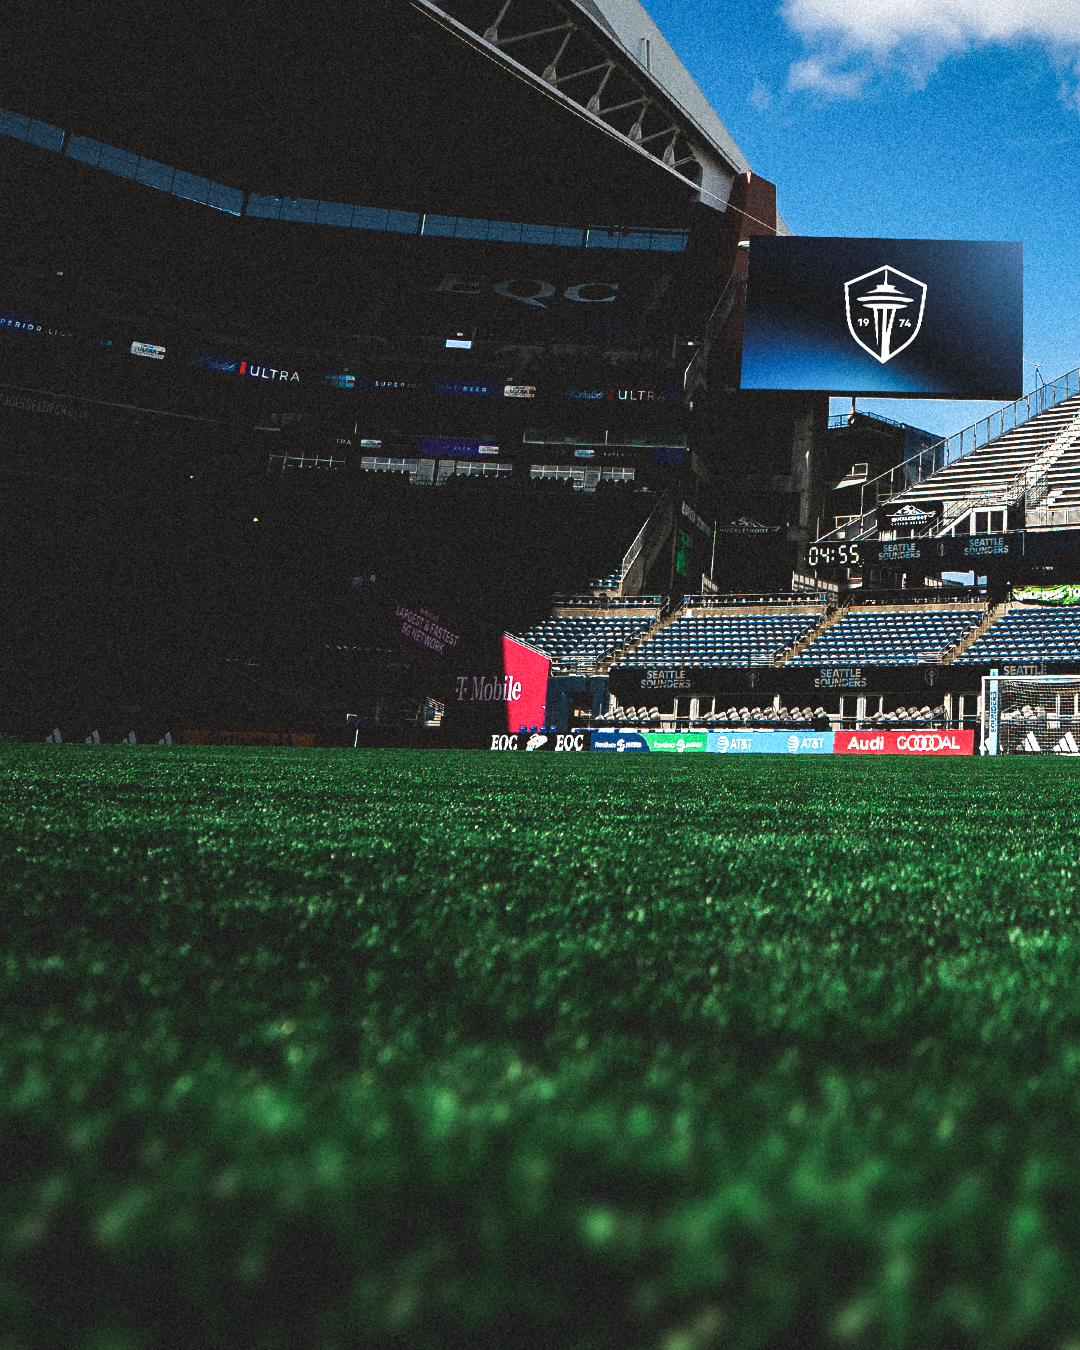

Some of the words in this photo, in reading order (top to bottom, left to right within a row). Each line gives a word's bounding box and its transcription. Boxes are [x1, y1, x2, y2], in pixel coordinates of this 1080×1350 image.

[429, 273, 620, 310] EQC
[857, 318, 870, 327] 19
[899, 318, 912, 328] 74
[249, 365, 300, 382] ULTRA
[617, 390, 666, 401] ULTRA
[969, 537, 1004, 546] SEATTLE
[883, 543, 916, 552] SEATTLE
[964, 545, 1009, 555] SOUNDERS
[808, 545, 859, 566] 04:55
[878, 550, 921, 560] SOUNDERS
[1066, 587, 1080, 598] TO
[395, 604, 425, 629] LARGEST
[429, 623, 460, 647] FASTEST
[401, 622, 412, 636] 5G
[411, 627, 445, 655] NETWORK
[647, 670, 685, 679] SEATTLE
[821, 669, 861, 678] SEATTLE
[1004, 664, 1047, 676] SEATTLE
[641, 679, 690, 689] SOUNDERS
[815, 678, 866, 688] SOUNDERS
[730, 738, 753, 750] AT&T
[800, 737, 824, 749] AT&T
[847, 736, 884, 750] Audi
